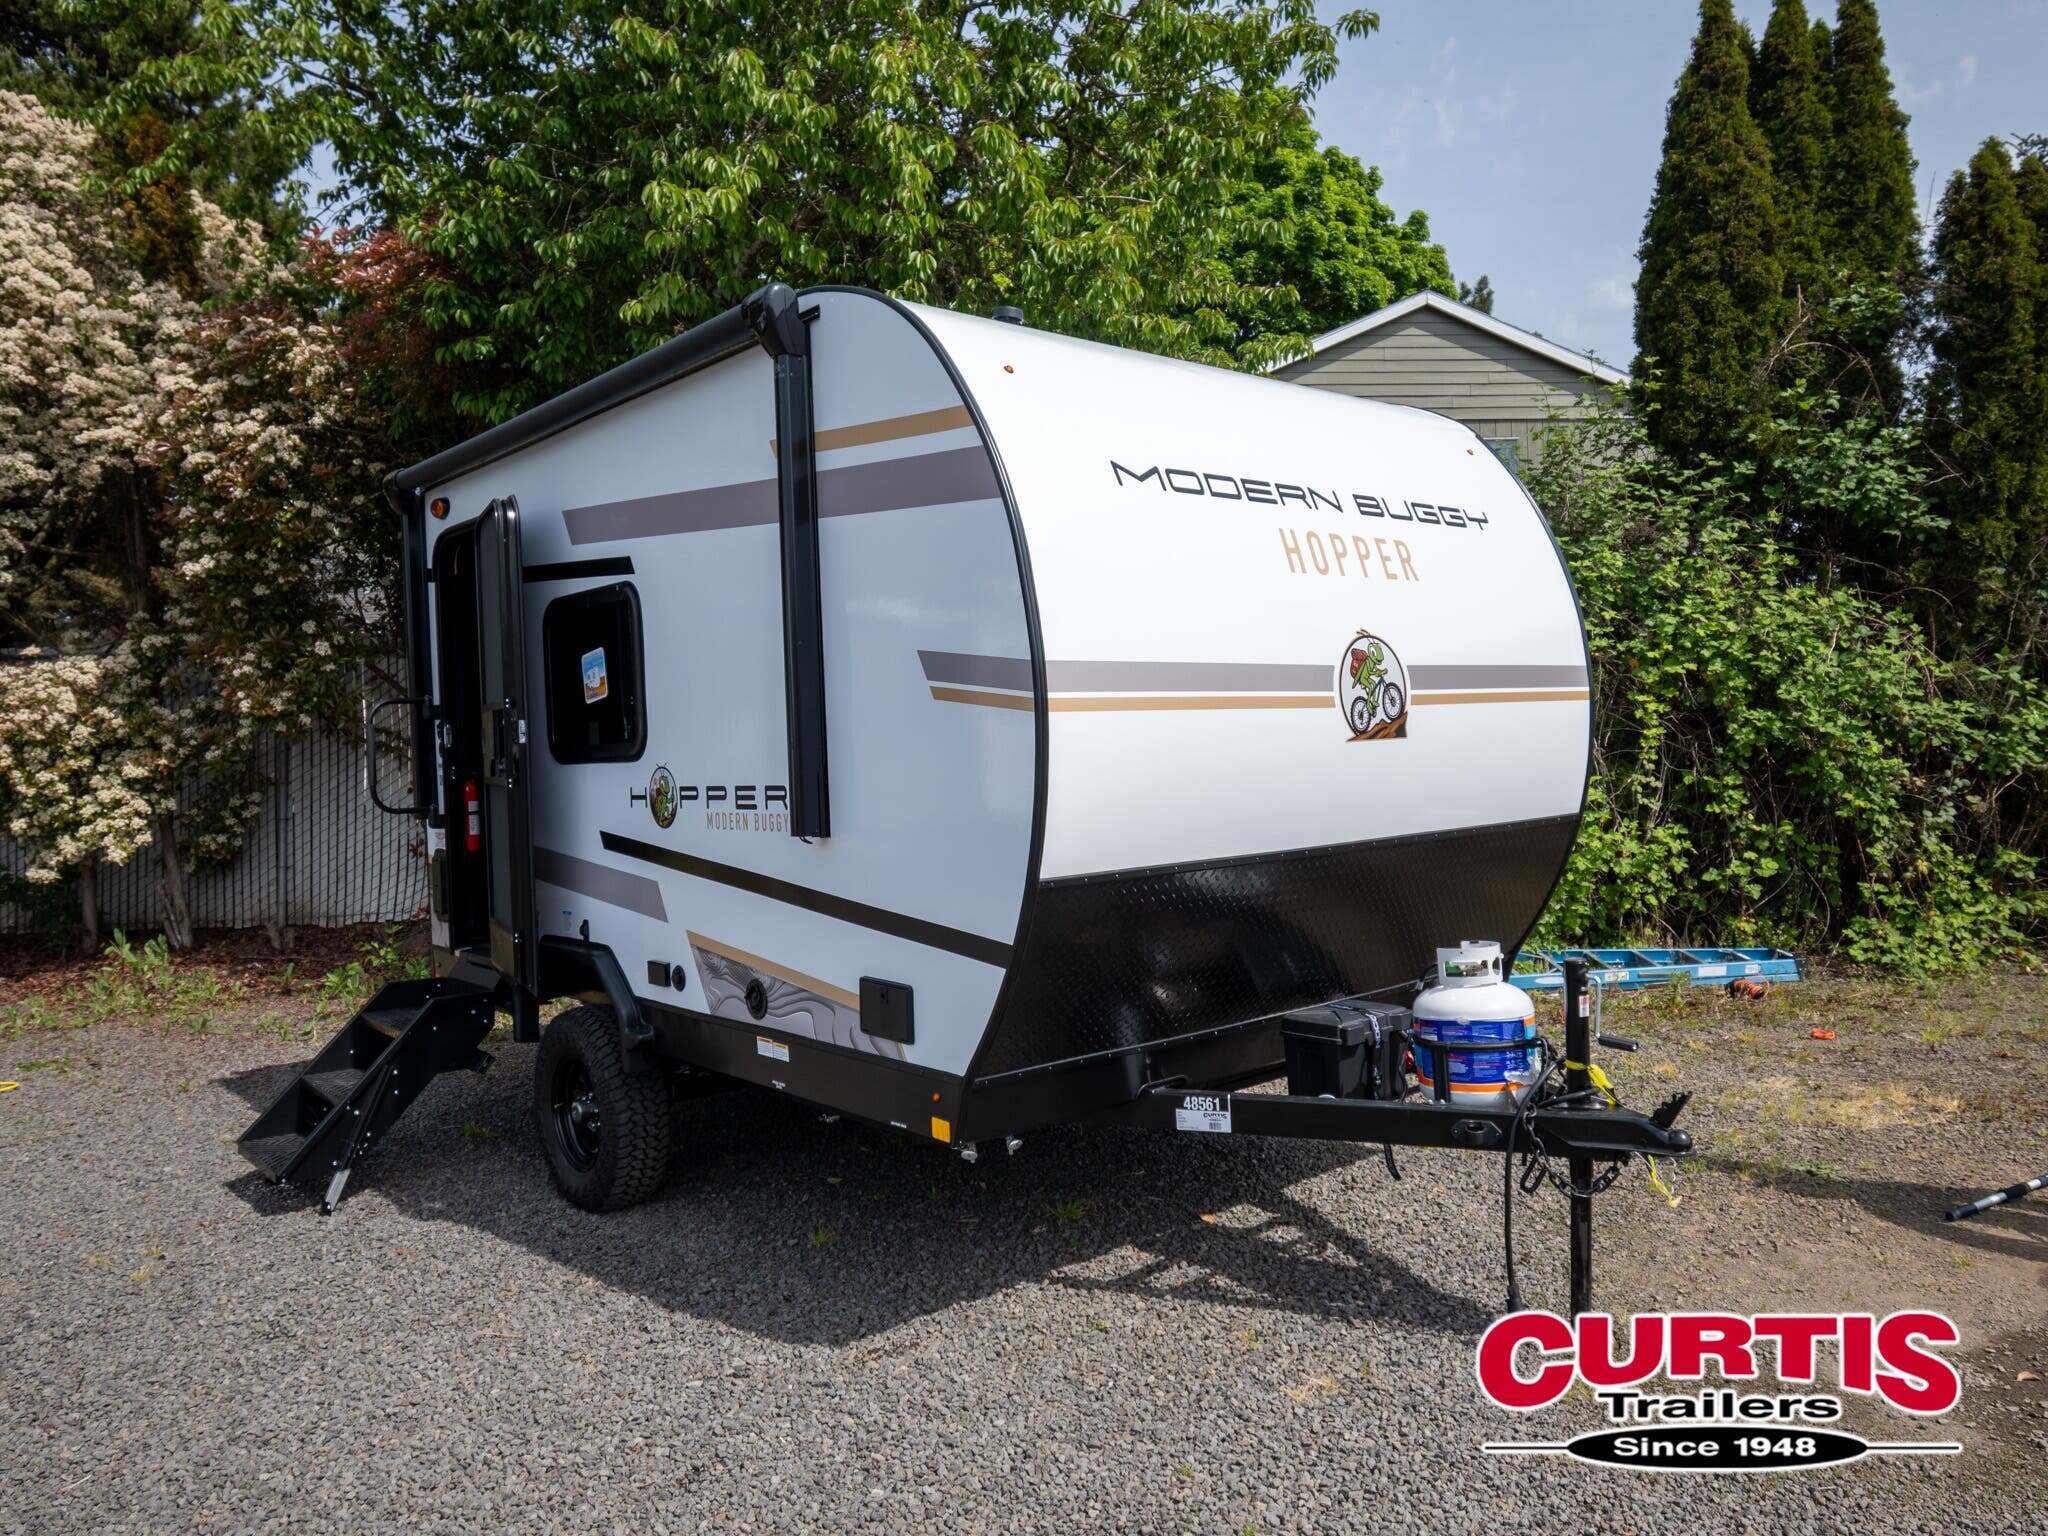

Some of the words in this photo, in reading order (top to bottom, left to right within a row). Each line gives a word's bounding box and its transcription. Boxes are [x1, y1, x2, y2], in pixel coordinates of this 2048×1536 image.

[1109, 459, 1344, 513] MODERN
[1351, 492, 1489, 531] BUGGY
[1278, 527, 1420, 582] HOPPER
[706, 812, 749, 832] MODERN
[754, 812, 789, 833] BUGGY
[1183, 1096, 1220, 1112] 48561
